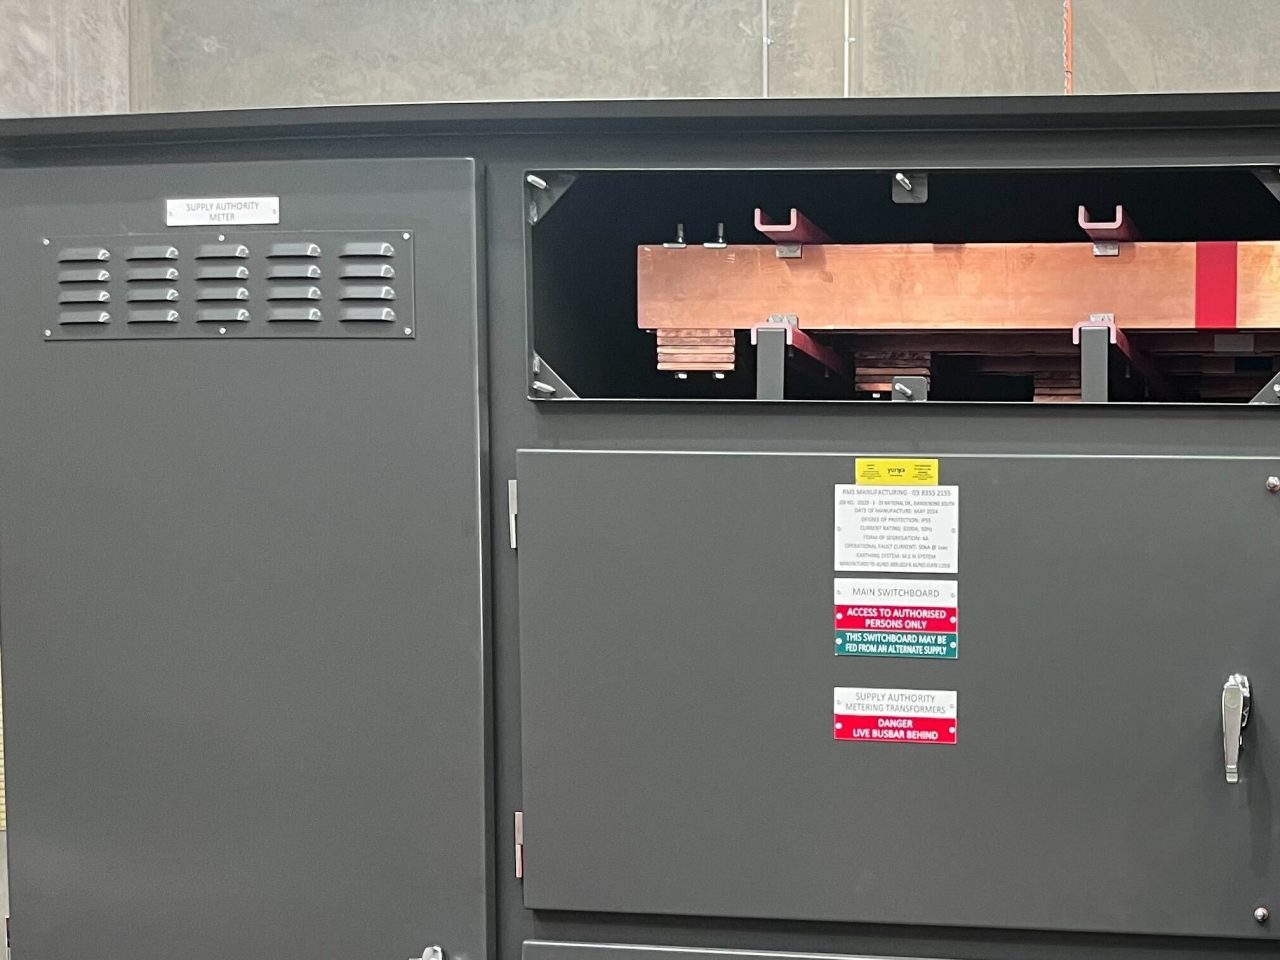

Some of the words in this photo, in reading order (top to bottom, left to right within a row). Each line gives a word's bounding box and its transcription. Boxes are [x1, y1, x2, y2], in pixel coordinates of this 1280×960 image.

[186, 202, 213, 211] SUPPLY
[215, 201, 259, 210] AUTHORITY
[209, 213, 235, 221] METER
[852, 588, 875, 596] MAIN
[877, 589, 940, 598] SWITCHBOARD
[846, 608, 877, 617] ACCESS
[879, 609, 892, 617] TO
[892, 609, 946, 619] AUTHORISED
[865, 619, 903, 628] PERSONS
[904, 620, 927, 629] ONLY
[845, 633, 862, 642] THIS
[863, 633, 917, 643] SWITCHBOARD
[918, 635, 936, 644] MAY
[937, 635, 947, 644] BE
[845, 643, 857, 652] FED
[858, 643, 877, 653] FROM
[877, 644, 887, 653] AN
[887, 644, 924, 654] ALTERNATE
[924, 646, 947, 655] SUPPLY
[855, 692, 885, 701] SUPPLY
[888, 693, 935, 703] AUTHORITY
[845, 703, 884, 712] METERING
[886, 704, 946, 713] TRANSFORMERS
[878, 719, 913, 728] DANGER
[852, 729, 870, 737] LIVE
[872, 729, 905, 739] BUSBAR
[906, 730, 938, 740] BEHIND
